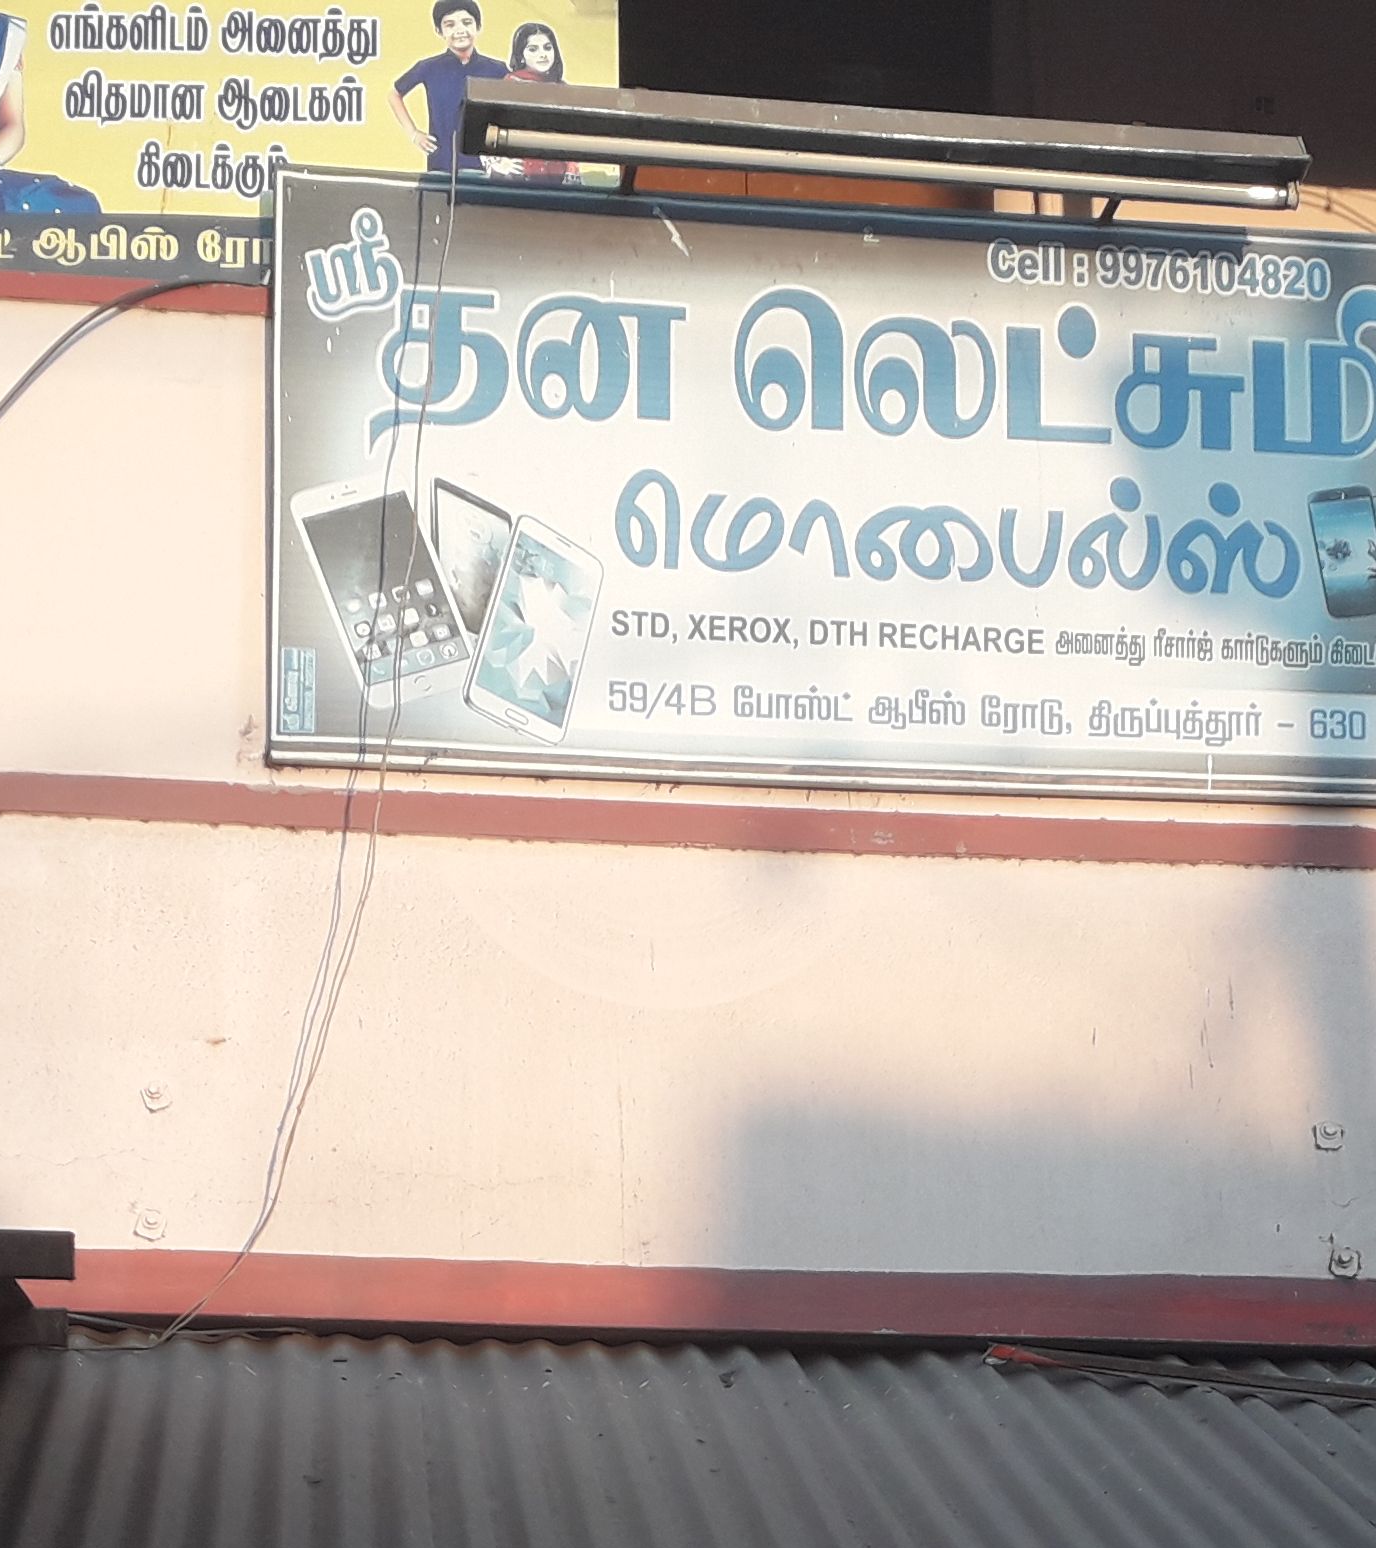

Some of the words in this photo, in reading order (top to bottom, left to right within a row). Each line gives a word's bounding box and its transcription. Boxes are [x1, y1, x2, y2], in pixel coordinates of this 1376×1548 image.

[50, 4, 208, 53] எங்களிடம்
[221, 4, 379, 63] அனைத்து
[66, 70, 205, 126] விதமான
[217, 75, 364, 131] ஆடைகள்
[197, 229, 274, 269] ரோ
[988, 240, 1065, 285] Cell
[1097, 248, 1331, 300] 9976104820
[366, 288, 688, 456] தன
[615, 467, 1300, 600] மொபைல்ஸ்
[612, 610, 677, 644] STD,
[688, 614, 798, 649] XEROX,
[810, 618, 867, 647] DTH
[879, 623, 1044, 654] RECHARGE
[1056, 626, 1145, 666] அனைத்து
[1154, 628, 1213, 662] ரீசார்ஜ்
[1221, 632, 1323, 669] கார்டுகளும்
[608, 680, 716, 719] 59/4B
[733, 685, 853, 722] போஸ்ட்
[868, 688, 966, 729] ஆபீஸ்
[980, 692, 1072, 736] ரோடு,
[1310, 708, 1366, 741] 630
